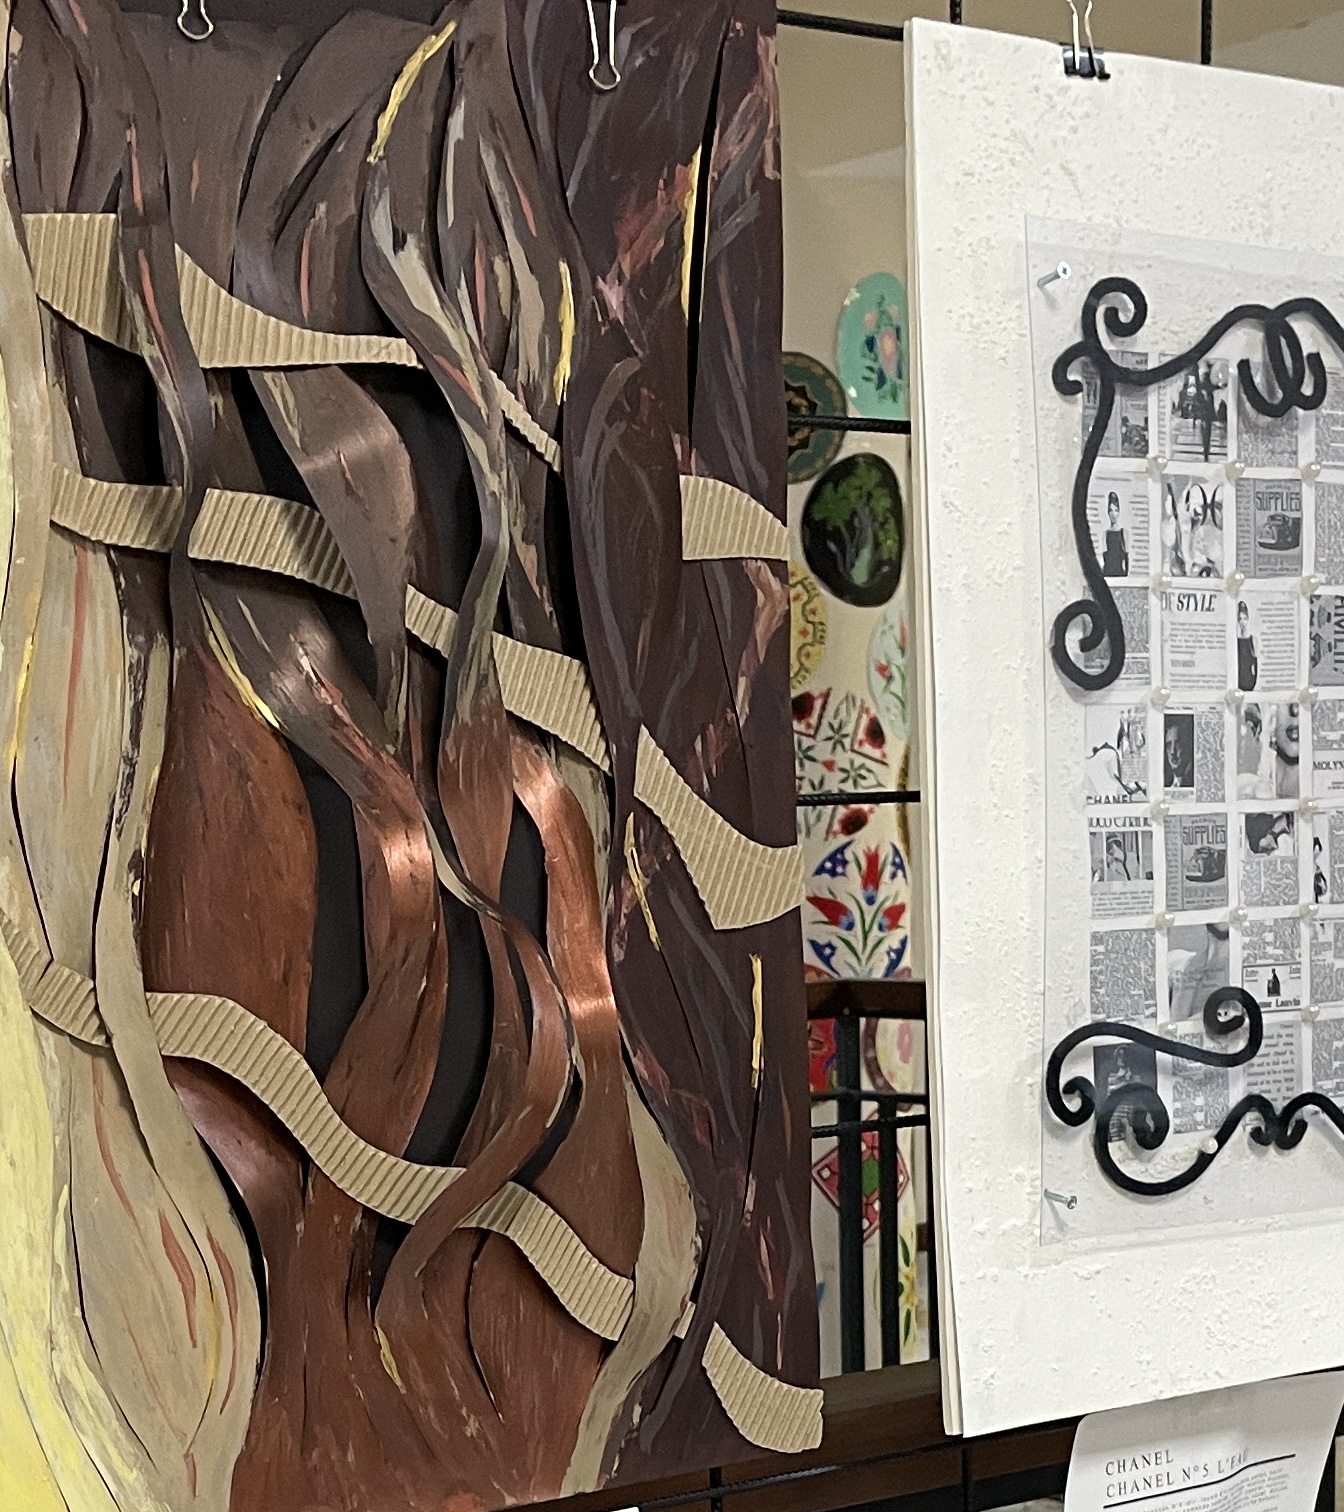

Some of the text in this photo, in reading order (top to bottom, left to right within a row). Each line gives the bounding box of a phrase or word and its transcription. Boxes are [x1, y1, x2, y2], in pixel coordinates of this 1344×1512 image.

[1176, 592, 1217, 611] STYLE
[1105, 1449, 1174, 1476] CHANEL
[1106, 1471, 1175, 1499] CHANEL
